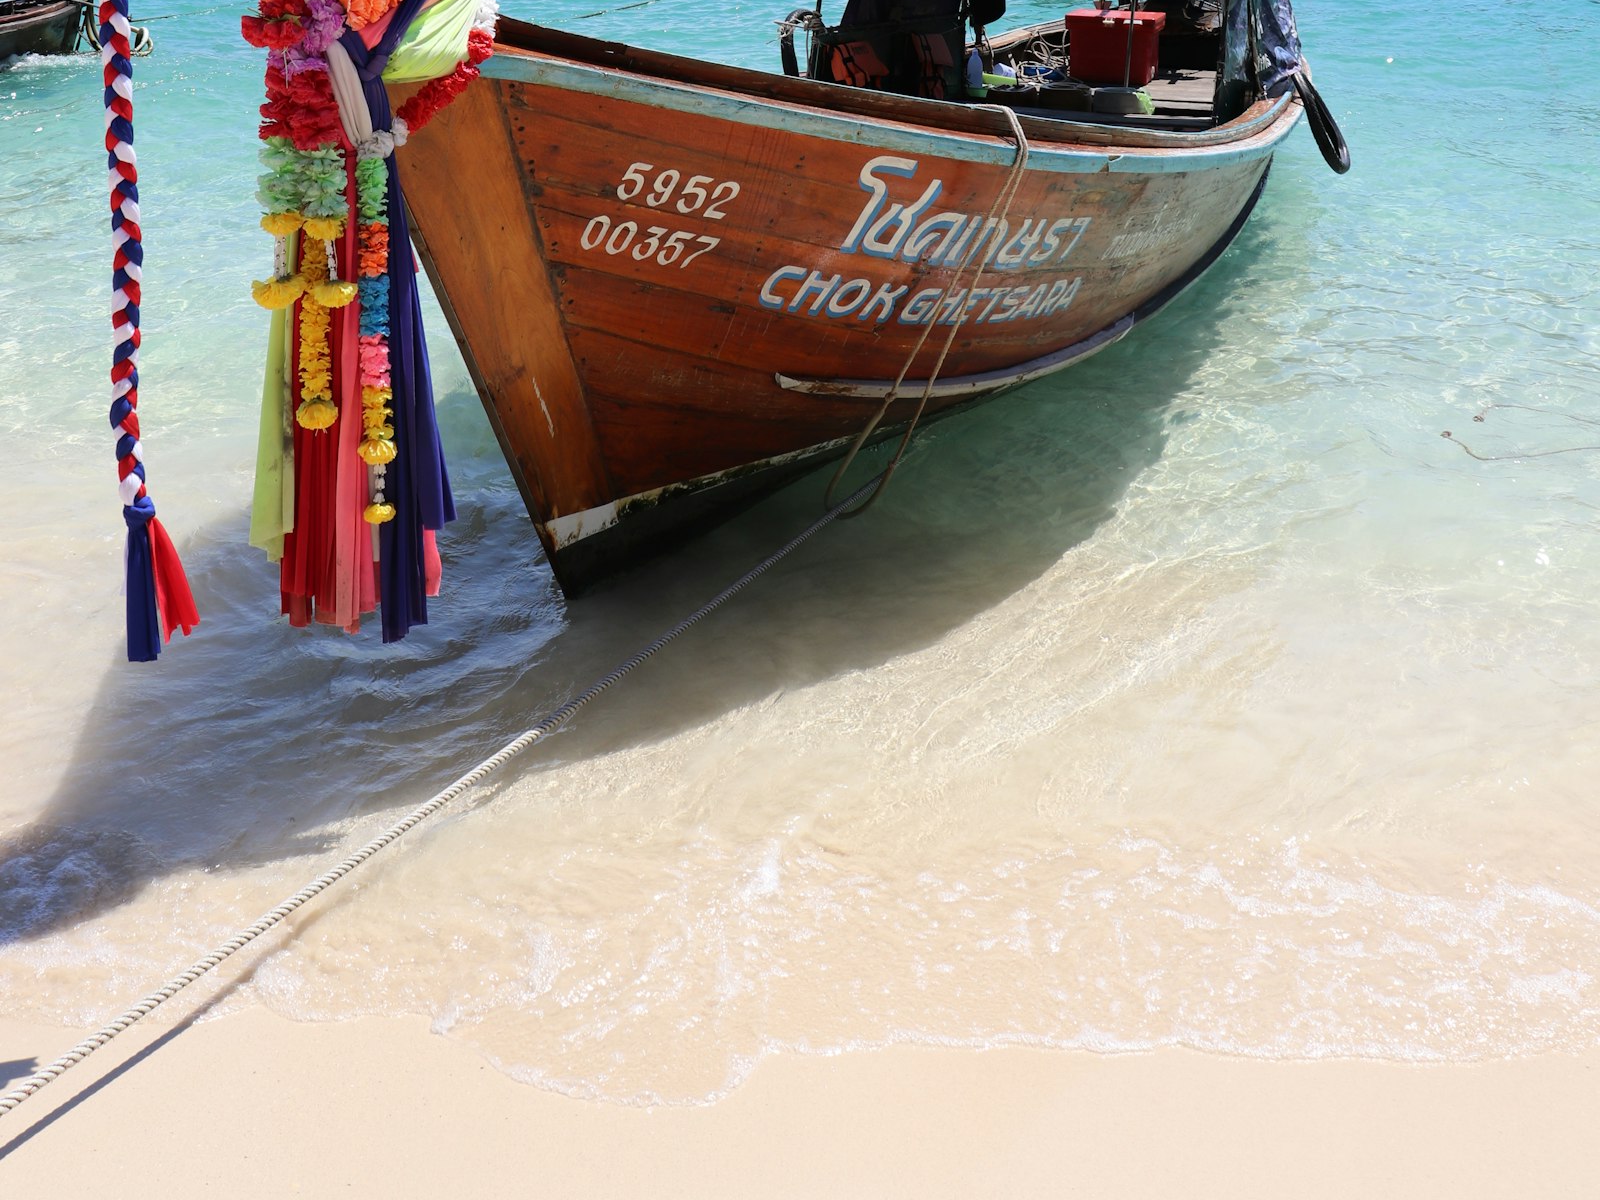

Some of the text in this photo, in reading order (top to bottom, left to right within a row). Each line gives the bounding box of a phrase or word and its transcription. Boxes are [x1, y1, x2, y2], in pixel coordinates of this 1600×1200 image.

[616, 162, 741, 220] 5952
[580, 215, 721, 269] 00357
[758, 265, 910, 323] CHOK
